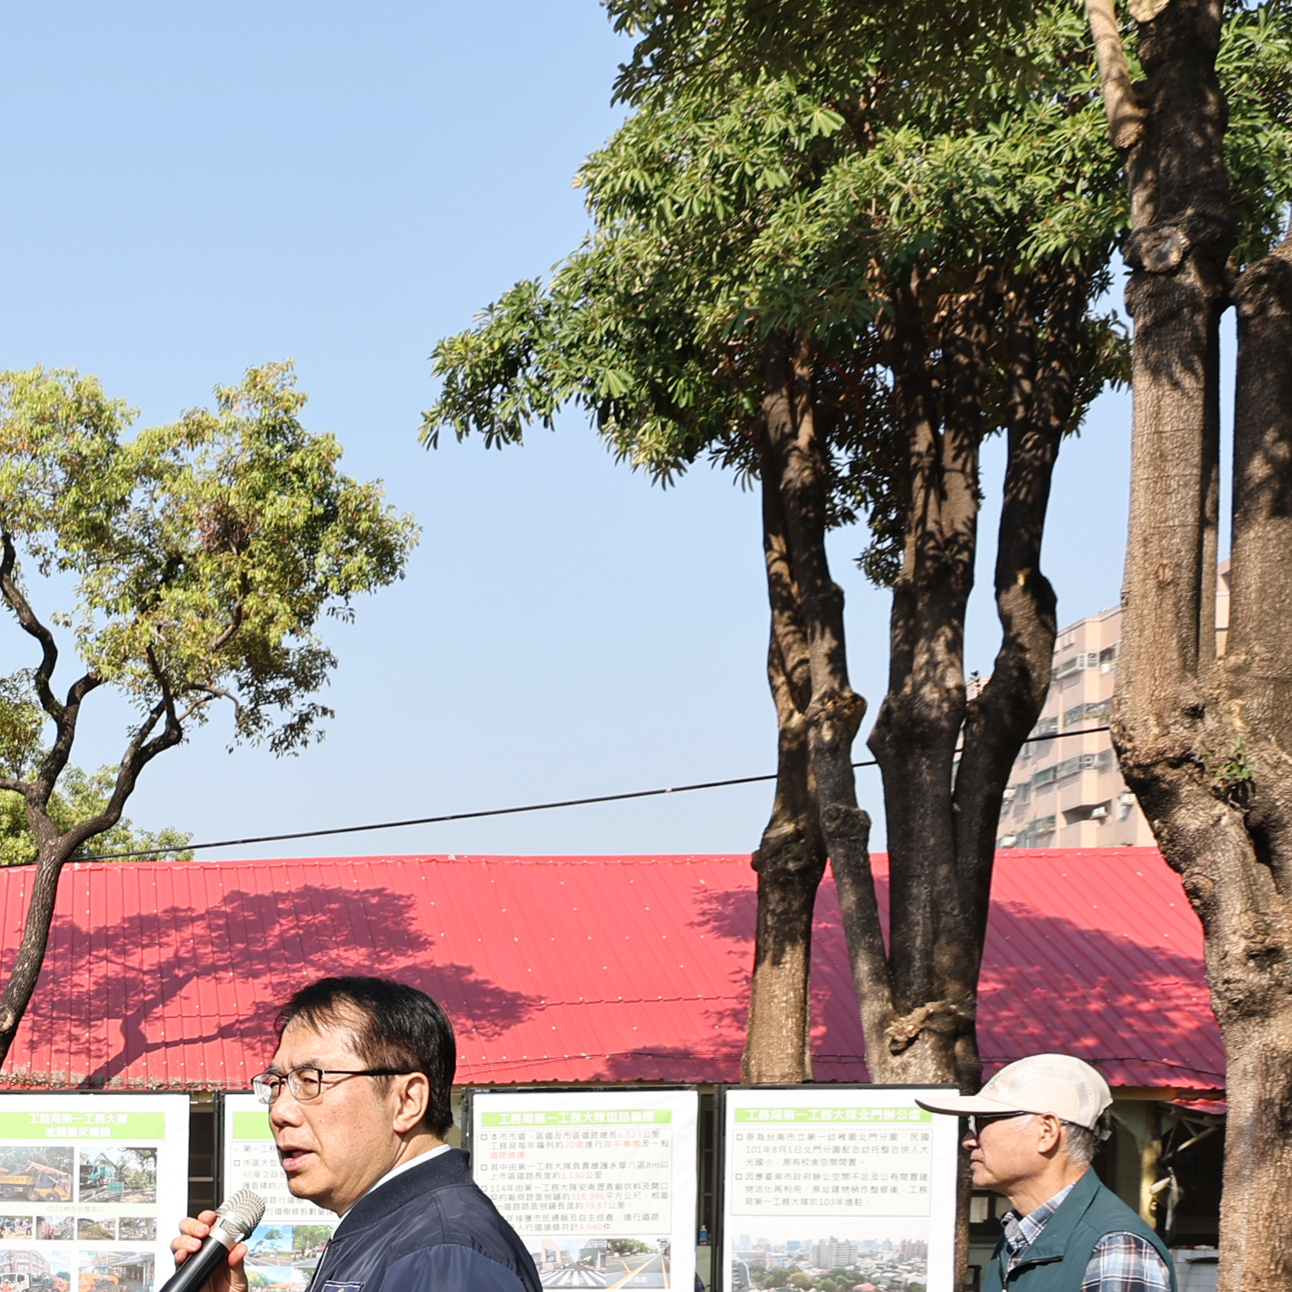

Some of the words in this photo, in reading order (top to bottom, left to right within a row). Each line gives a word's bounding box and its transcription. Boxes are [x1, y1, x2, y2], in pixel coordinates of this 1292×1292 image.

[28, 1114, 128, 1124] 工務局第一工務大隊
[498, 1110, 655, 1126] 工務局第一工務大隊道路養護
[745, 1108, 921, 1121] 工務局第一工務大隊北門辦公處
